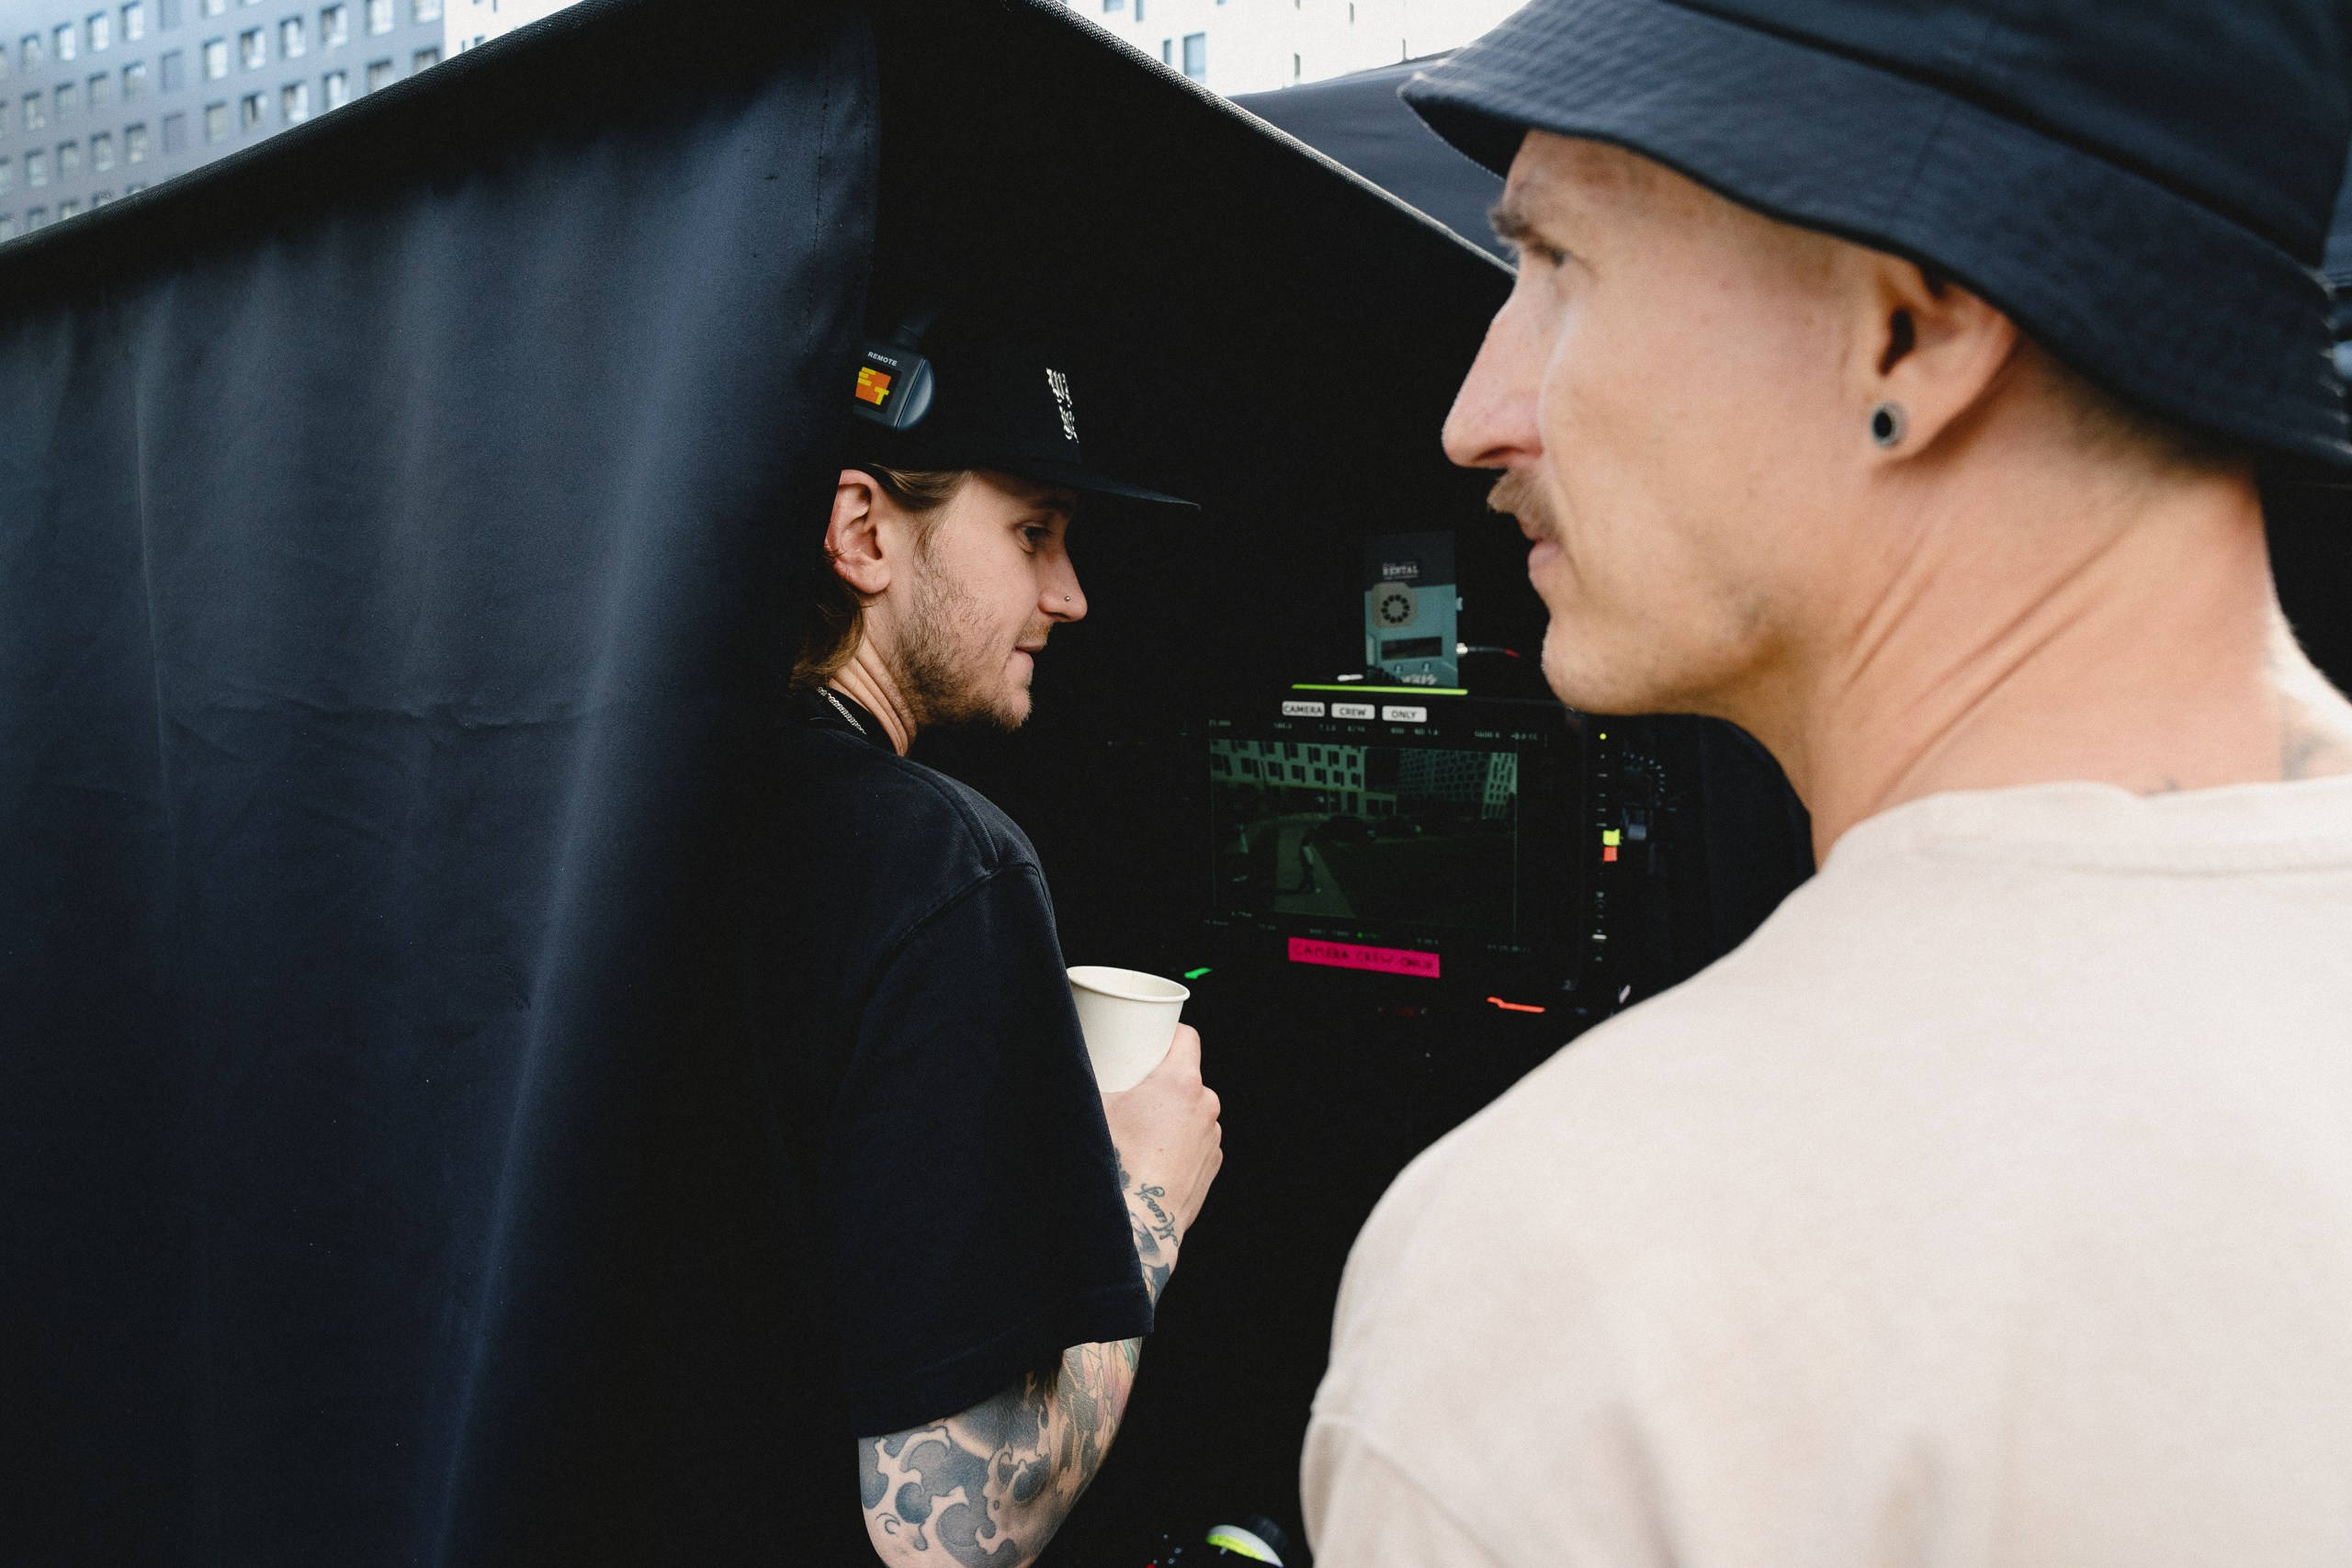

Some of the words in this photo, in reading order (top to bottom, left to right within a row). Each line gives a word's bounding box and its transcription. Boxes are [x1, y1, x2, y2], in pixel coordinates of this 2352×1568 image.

[867, 351, 898, 367] REMOTE
[1283, 703, 1323, 714] CAMERA
[1339, 707, 1367, 716] CREW
[1391, 710, 1417, 719] ONLY
